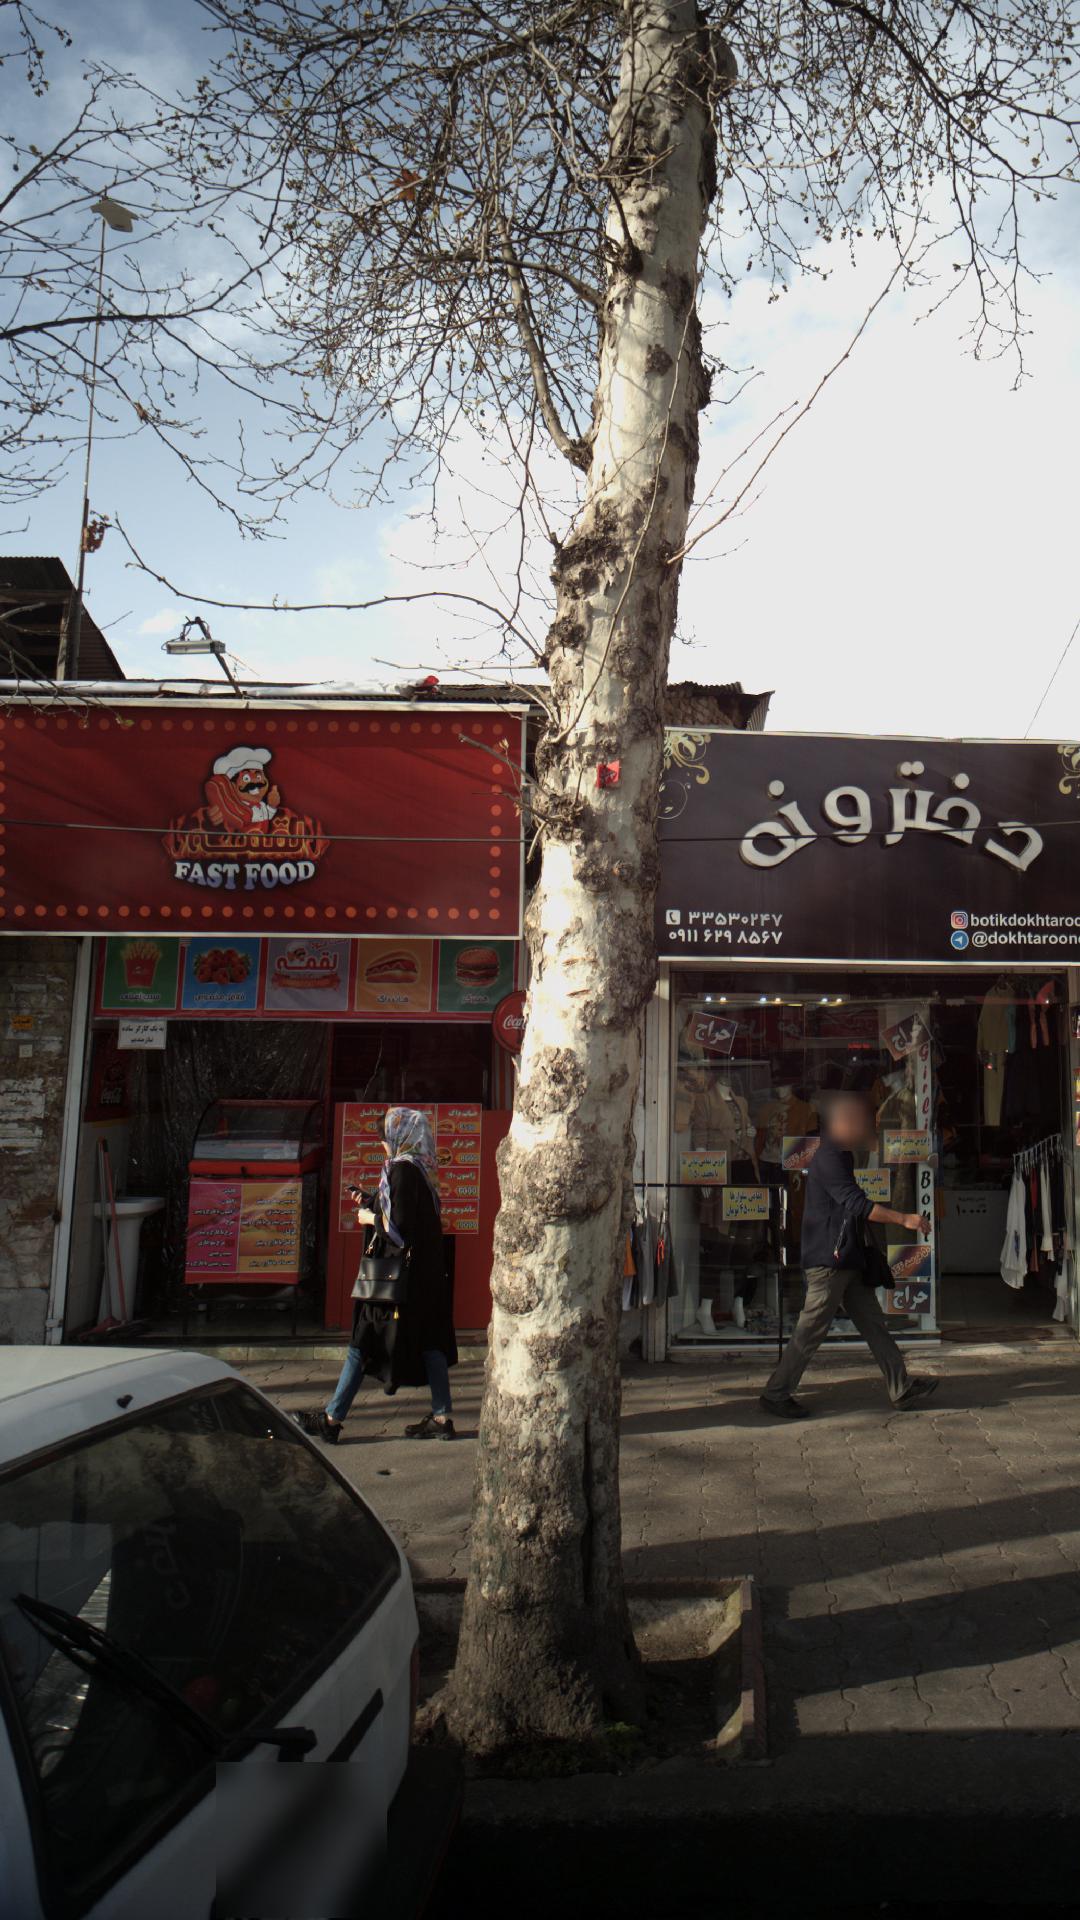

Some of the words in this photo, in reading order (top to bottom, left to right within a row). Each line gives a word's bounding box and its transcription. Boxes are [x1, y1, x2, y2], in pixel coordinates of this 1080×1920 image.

[739, 761, 1043, 873] دخترونه
[174, 862, 240, 890] FAST
[243, 861, 316, 890] FOOD
[688, 911, 783, 927] ۳۳۵۳۰۲۴۷
[668, 928, 699, 943] ۰۹۱۱
[703, 929, 733, 944] ۶۲۹
[736, 930, 783, 944] ۸۵۶۷
[971, 931, 1080, 948] @dokhtaroon
[695, 1020, 732, 1046] حراج
[893, 1285, 929, 1311] حراج
